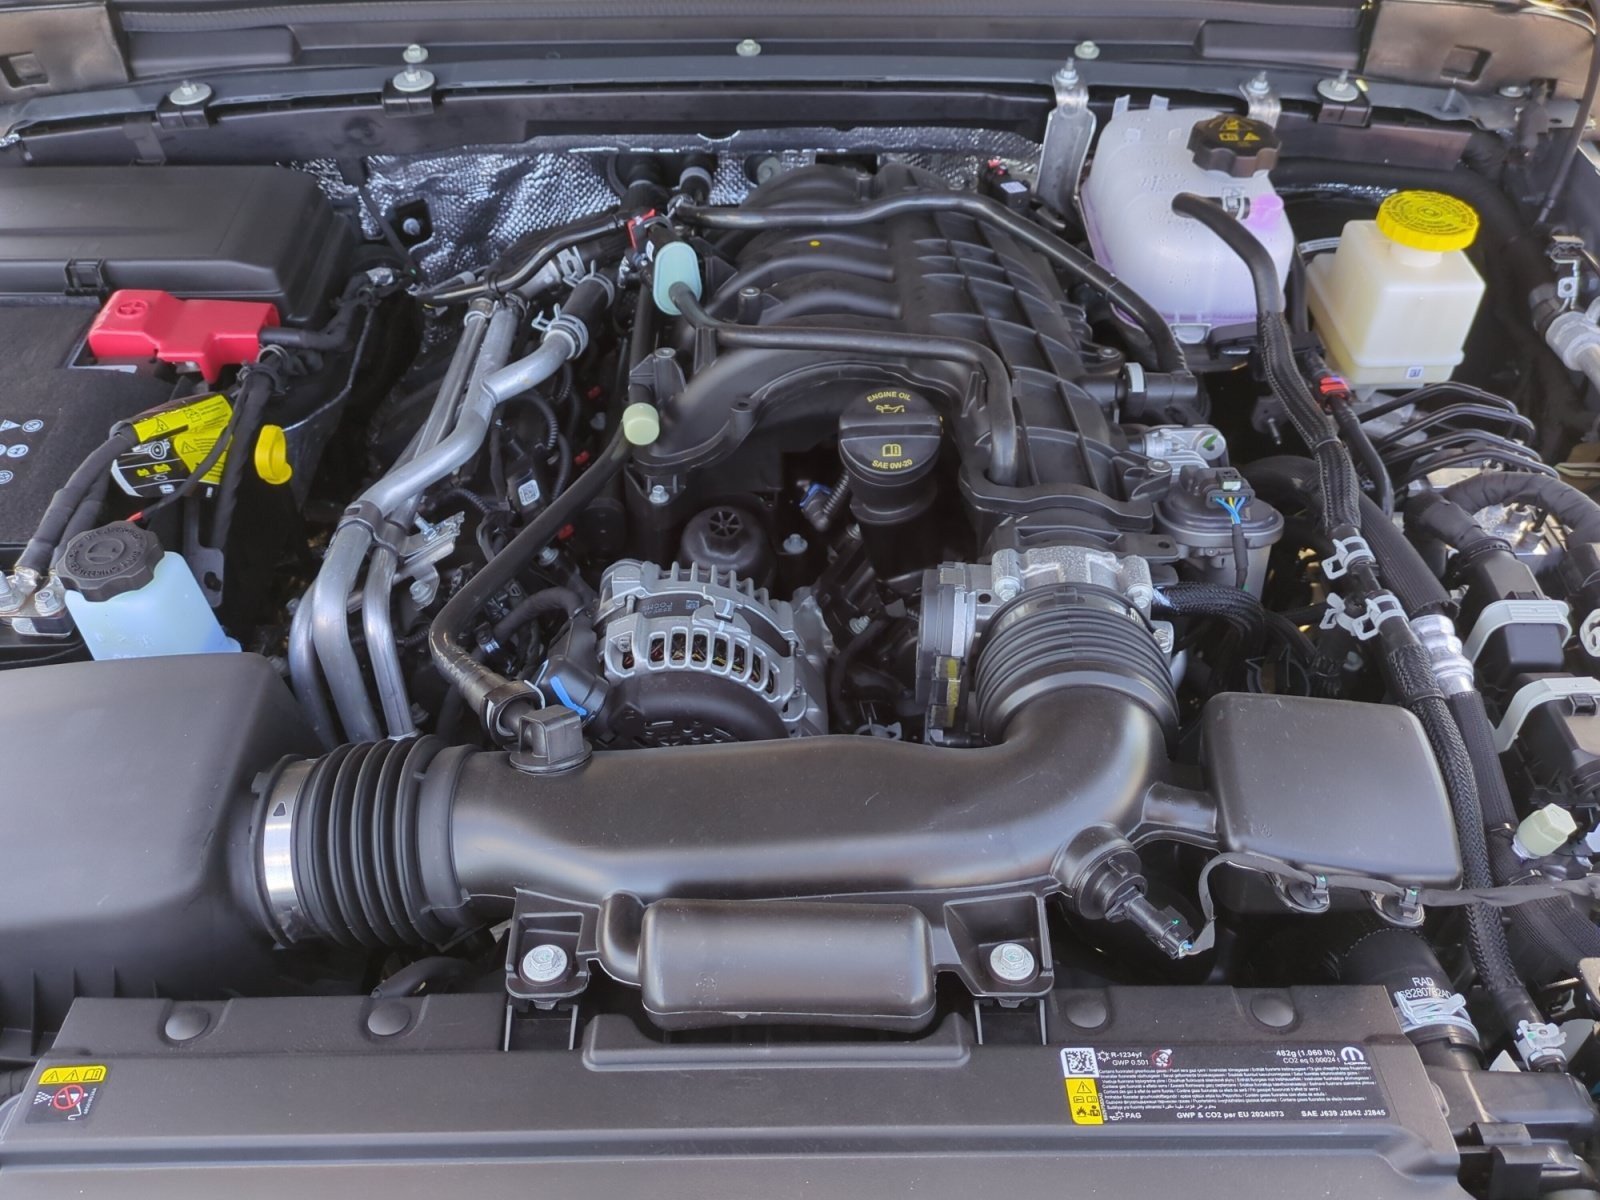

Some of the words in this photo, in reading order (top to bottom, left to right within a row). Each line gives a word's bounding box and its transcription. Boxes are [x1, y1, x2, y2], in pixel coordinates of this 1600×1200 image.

[866, 391, 897, 403] ENGINE
[898, 391, 912, 402] OIL
[872, 459, 888, 469] SAE
[889, 458, 913, 469] 0W-20
[1411, 976, 1434, 987] RAD
[1110, 1051, 1143, 1060] R-1234yf
[1276, 1049, 1297, 1058] 482g
[1297, 1049, 1323, 1057] (1.060
[1323, 1049, 1336, 1057] lb)
[1309, 1056, 1336, 1064] 0.00024
[1251, 1110, 1285, 1118] 2024/573
[1340, 1109, 1362, 1117] J2842
